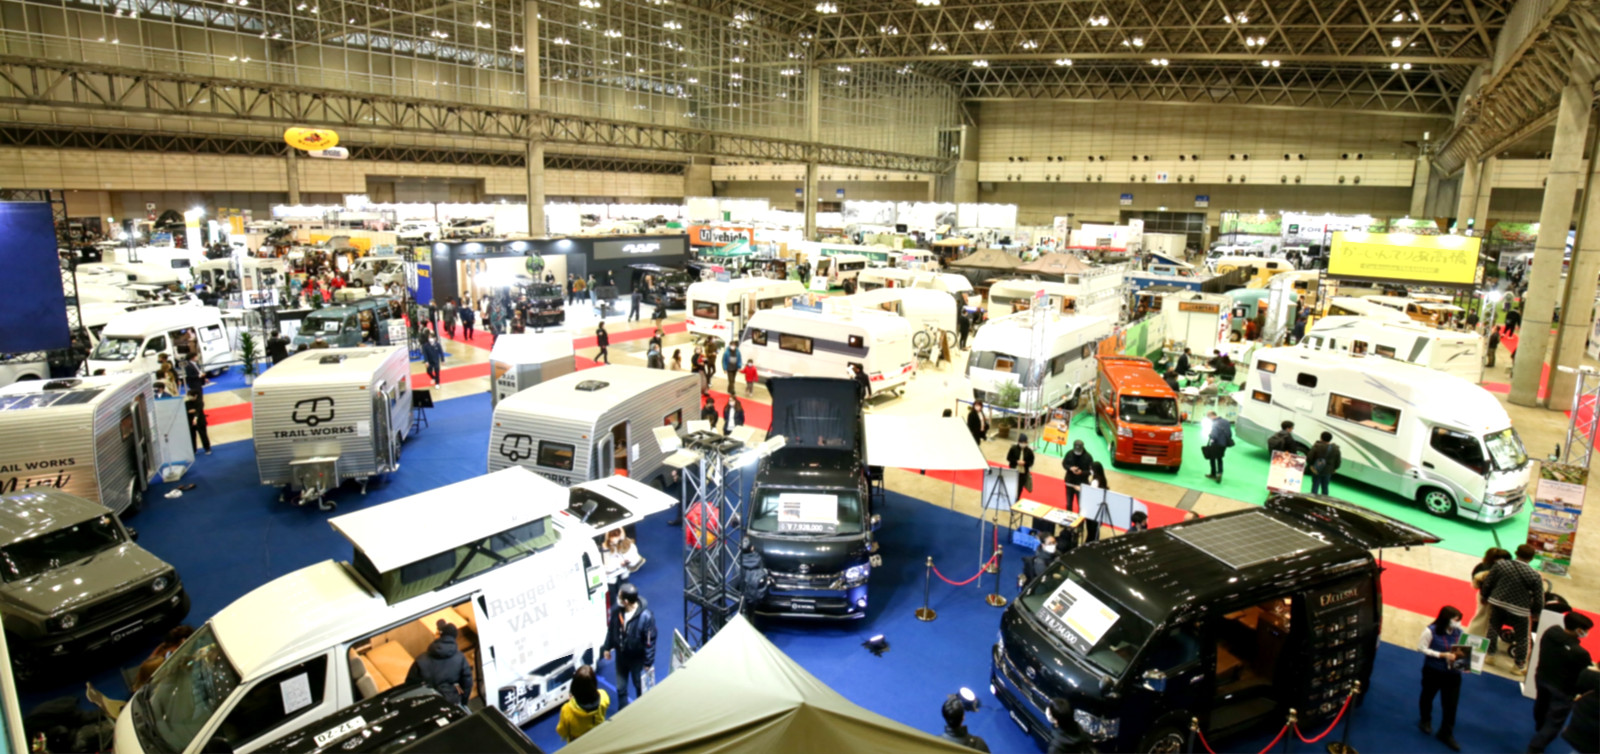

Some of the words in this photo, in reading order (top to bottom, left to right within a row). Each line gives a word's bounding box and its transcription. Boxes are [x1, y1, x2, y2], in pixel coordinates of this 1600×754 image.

[273, 429, 307, 438] TRAIL
[310, 426, 354, 436] WORKS
[25, 457, 76, 470] WORKS
[489, 575, 556, 618] Rugged
[507, 602, 549, 633] VAN
